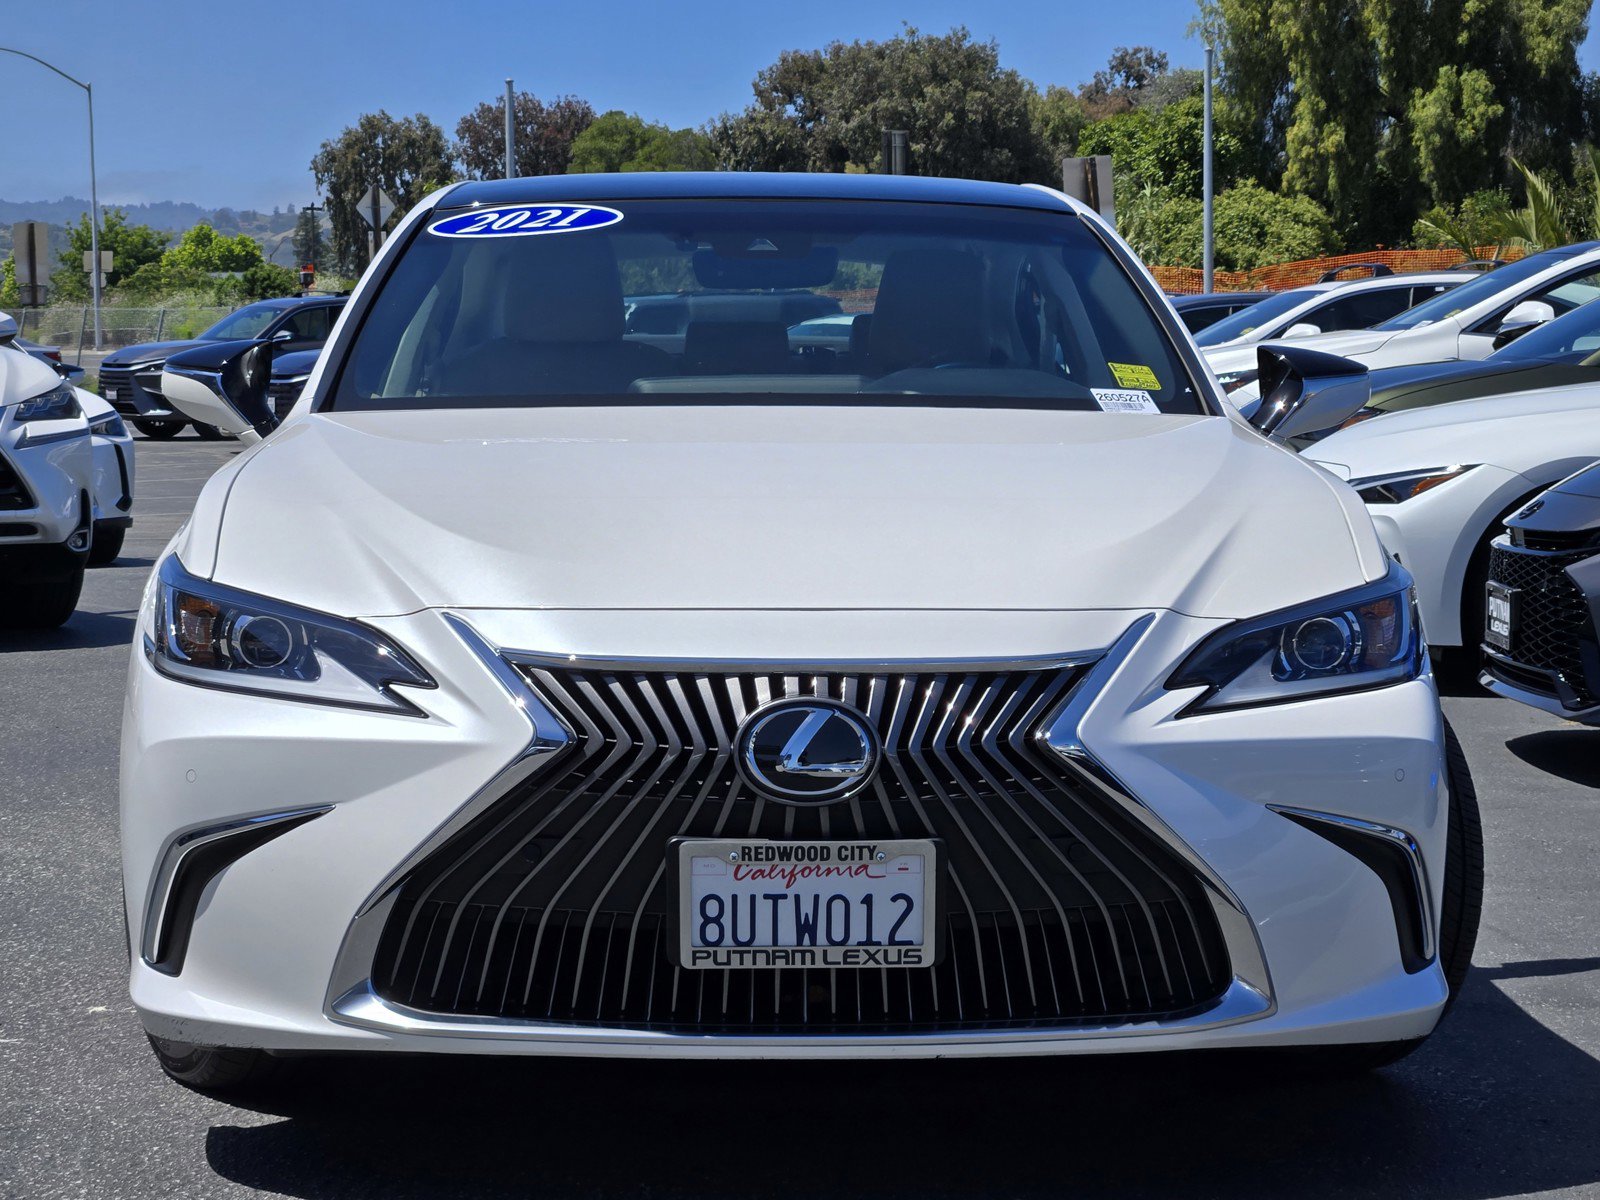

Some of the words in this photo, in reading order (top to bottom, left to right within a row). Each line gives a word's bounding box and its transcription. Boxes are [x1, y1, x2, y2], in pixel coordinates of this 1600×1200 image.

[455, 208, 592, 233] 2021
[1096, 392, 1151, 403] 260527A
[741, 845, 832, 862] REDWOOD
[837, 845, 878, 861] CITY
[733, 863, 886, 889] California
[699, 892, 915, 947] 8UTW012
[691, 949, 816, 967] PUTNAM
[822, 948, 923, 966] LEXUS
